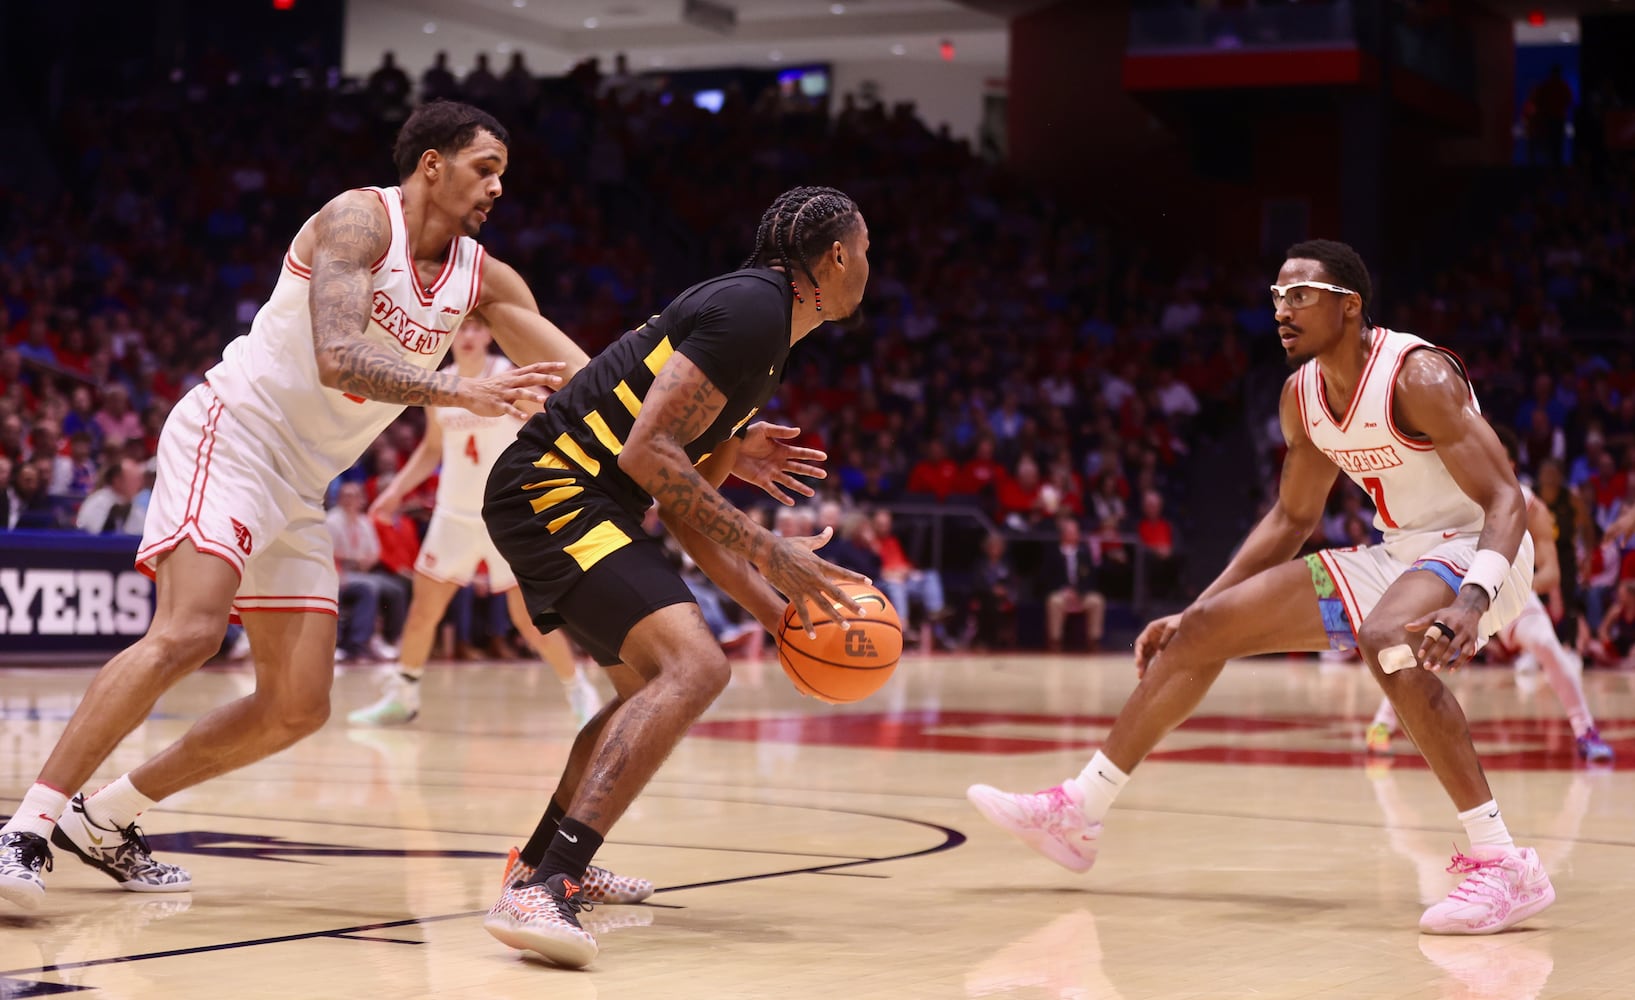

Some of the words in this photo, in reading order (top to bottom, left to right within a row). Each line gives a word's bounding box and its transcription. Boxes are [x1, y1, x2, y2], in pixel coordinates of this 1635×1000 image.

[372, 290, 450, 355] DAYTO
[465, 433, 479, 465] 4
[1361, 477, 1400, 529] 7
